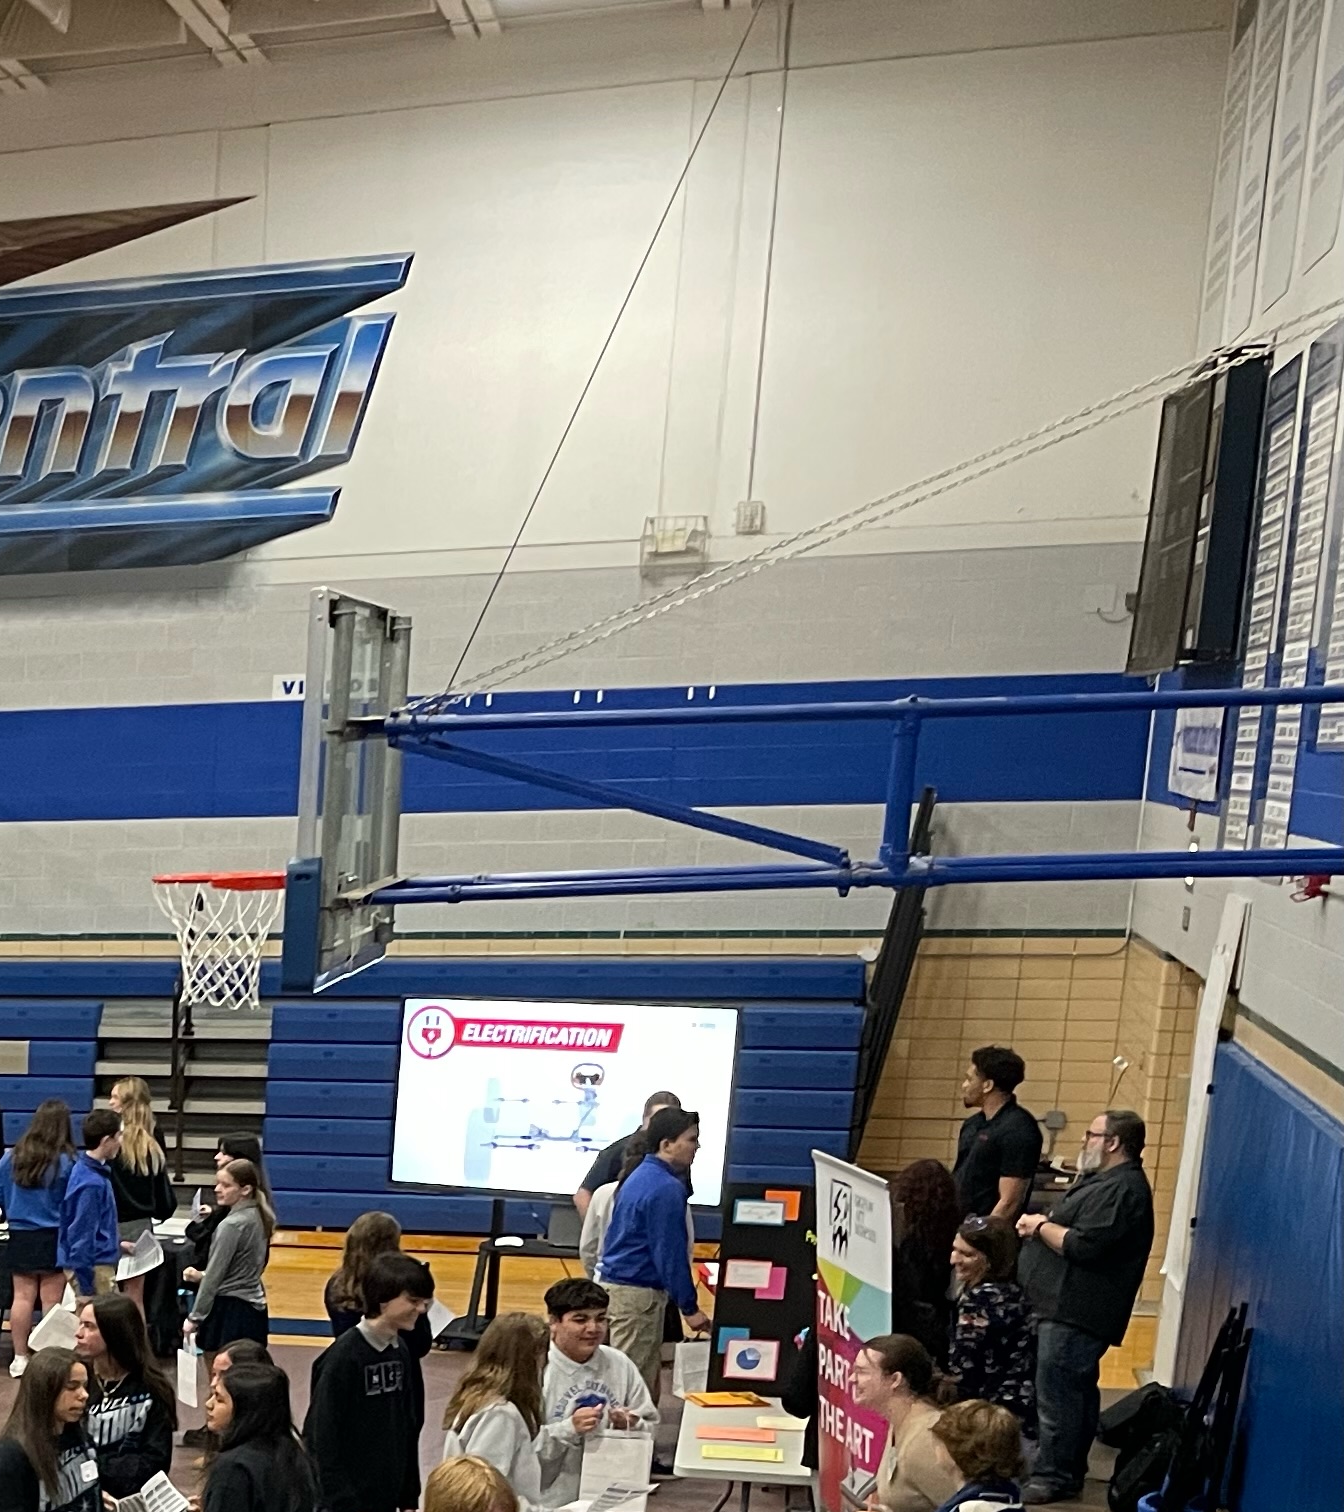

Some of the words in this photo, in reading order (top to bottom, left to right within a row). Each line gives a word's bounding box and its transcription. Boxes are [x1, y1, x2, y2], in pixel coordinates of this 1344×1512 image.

[462, 1023, 613, 1048] ELECTRIFICATION
[817, 1289, 852, 1342] TAKE
[818, 1342, 851, 1394] PART
[819, 1394, 845, 1444] THE
[845, 1415, 874, 1465] ART
